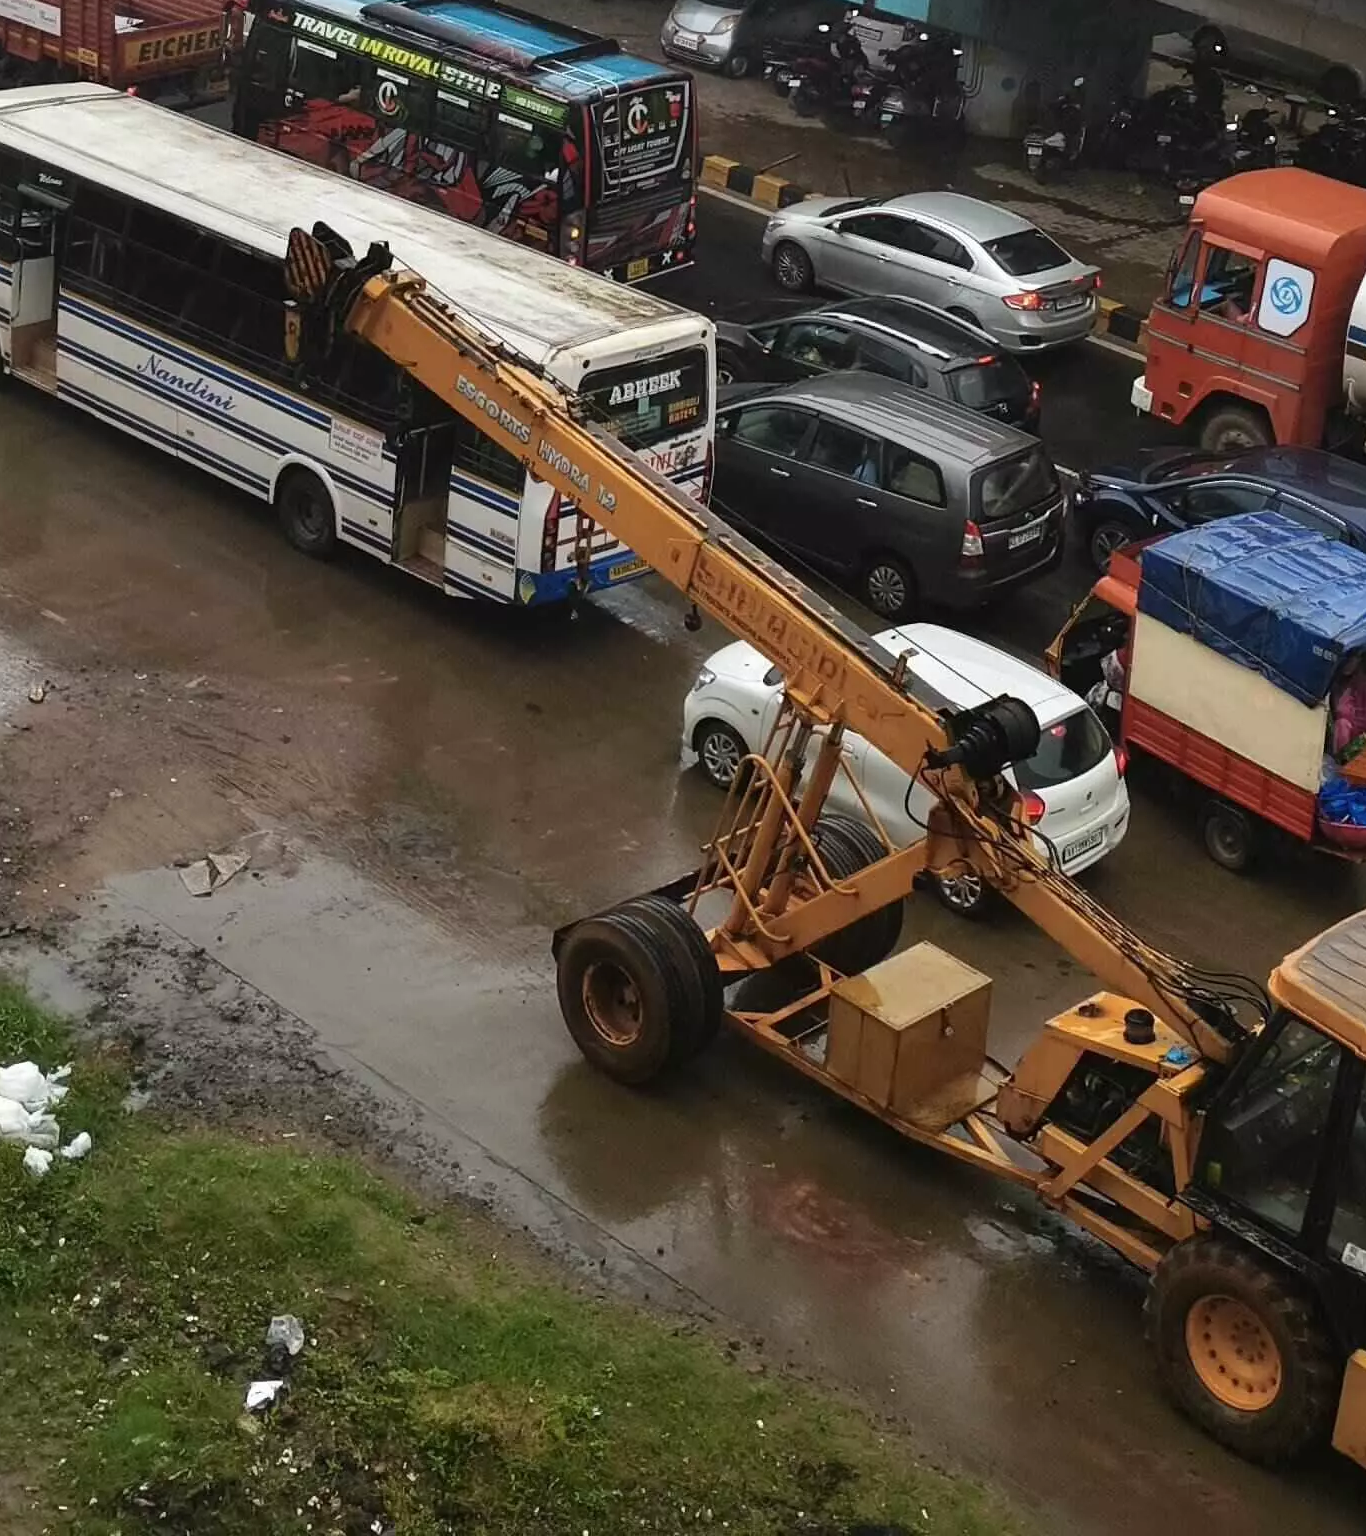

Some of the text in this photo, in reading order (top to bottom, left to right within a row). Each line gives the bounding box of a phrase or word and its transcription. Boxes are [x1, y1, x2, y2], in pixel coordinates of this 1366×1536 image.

[138, 29, 221, 62] EICHER
[292, 12, 502, 100] TRAVEL IN ROYAL STYLE
[136, 353, 237, 412] Nandini
[608, 369, 682, 406] ABHEEK
[455, 373, 617, 512] ESCORTS HYDRA 12
